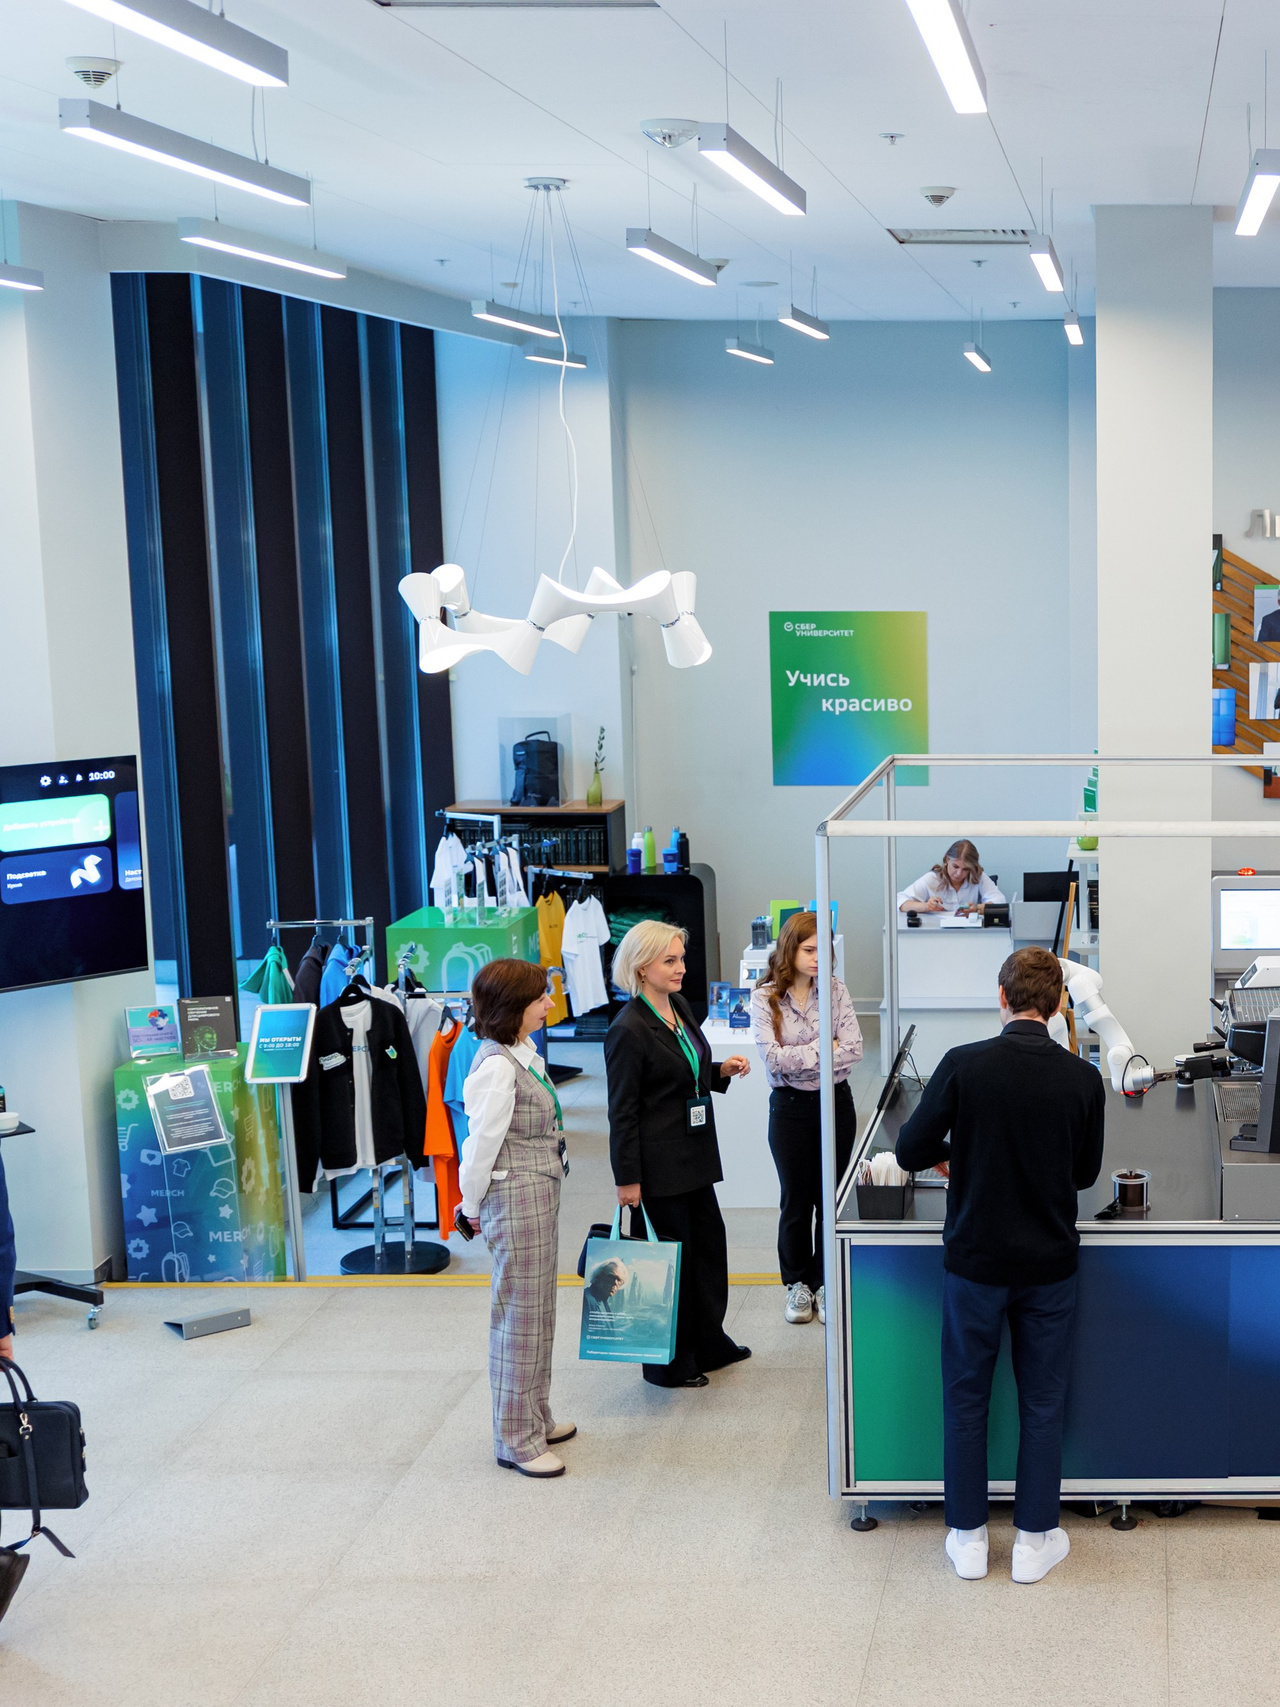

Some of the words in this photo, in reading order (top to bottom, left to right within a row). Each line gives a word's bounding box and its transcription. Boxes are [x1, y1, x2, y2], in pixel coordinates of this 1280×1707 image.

[786, 670, 850, 687] Учись
[822, 698, 912, 715] красиво
[88, 770, 115, 781] 10:00
[125, 869, 142, 877] Наст
[151, 1189, 184, 1197] MERCH
